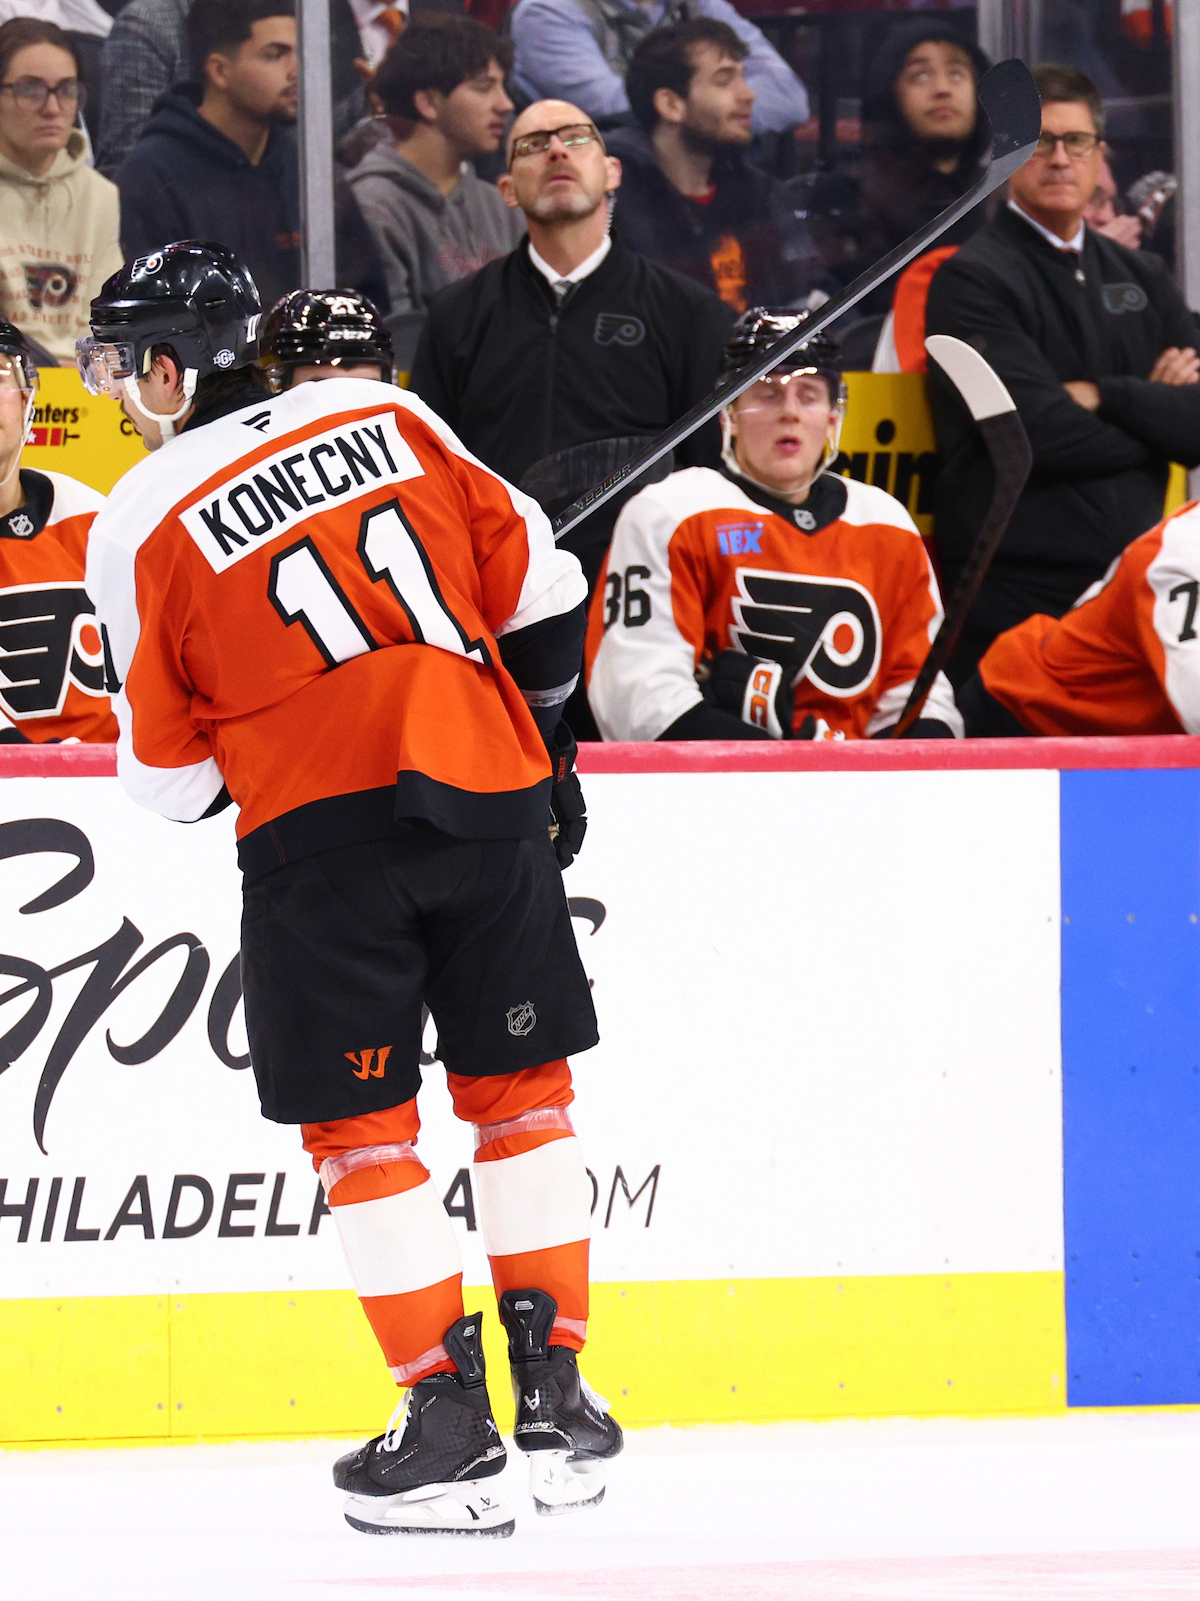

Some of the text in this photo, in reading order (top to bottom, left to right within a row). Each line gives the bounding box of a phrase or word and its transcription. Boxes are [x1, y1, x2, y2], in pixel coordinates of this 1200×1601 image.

[329, 330, 373, 341] CCM
[32, 403, 80, 424] nters
[200, 423, 398, 556] KONECNY
[717, 529, 763, 556] IBX
[267, 498, 493, 668] 11
